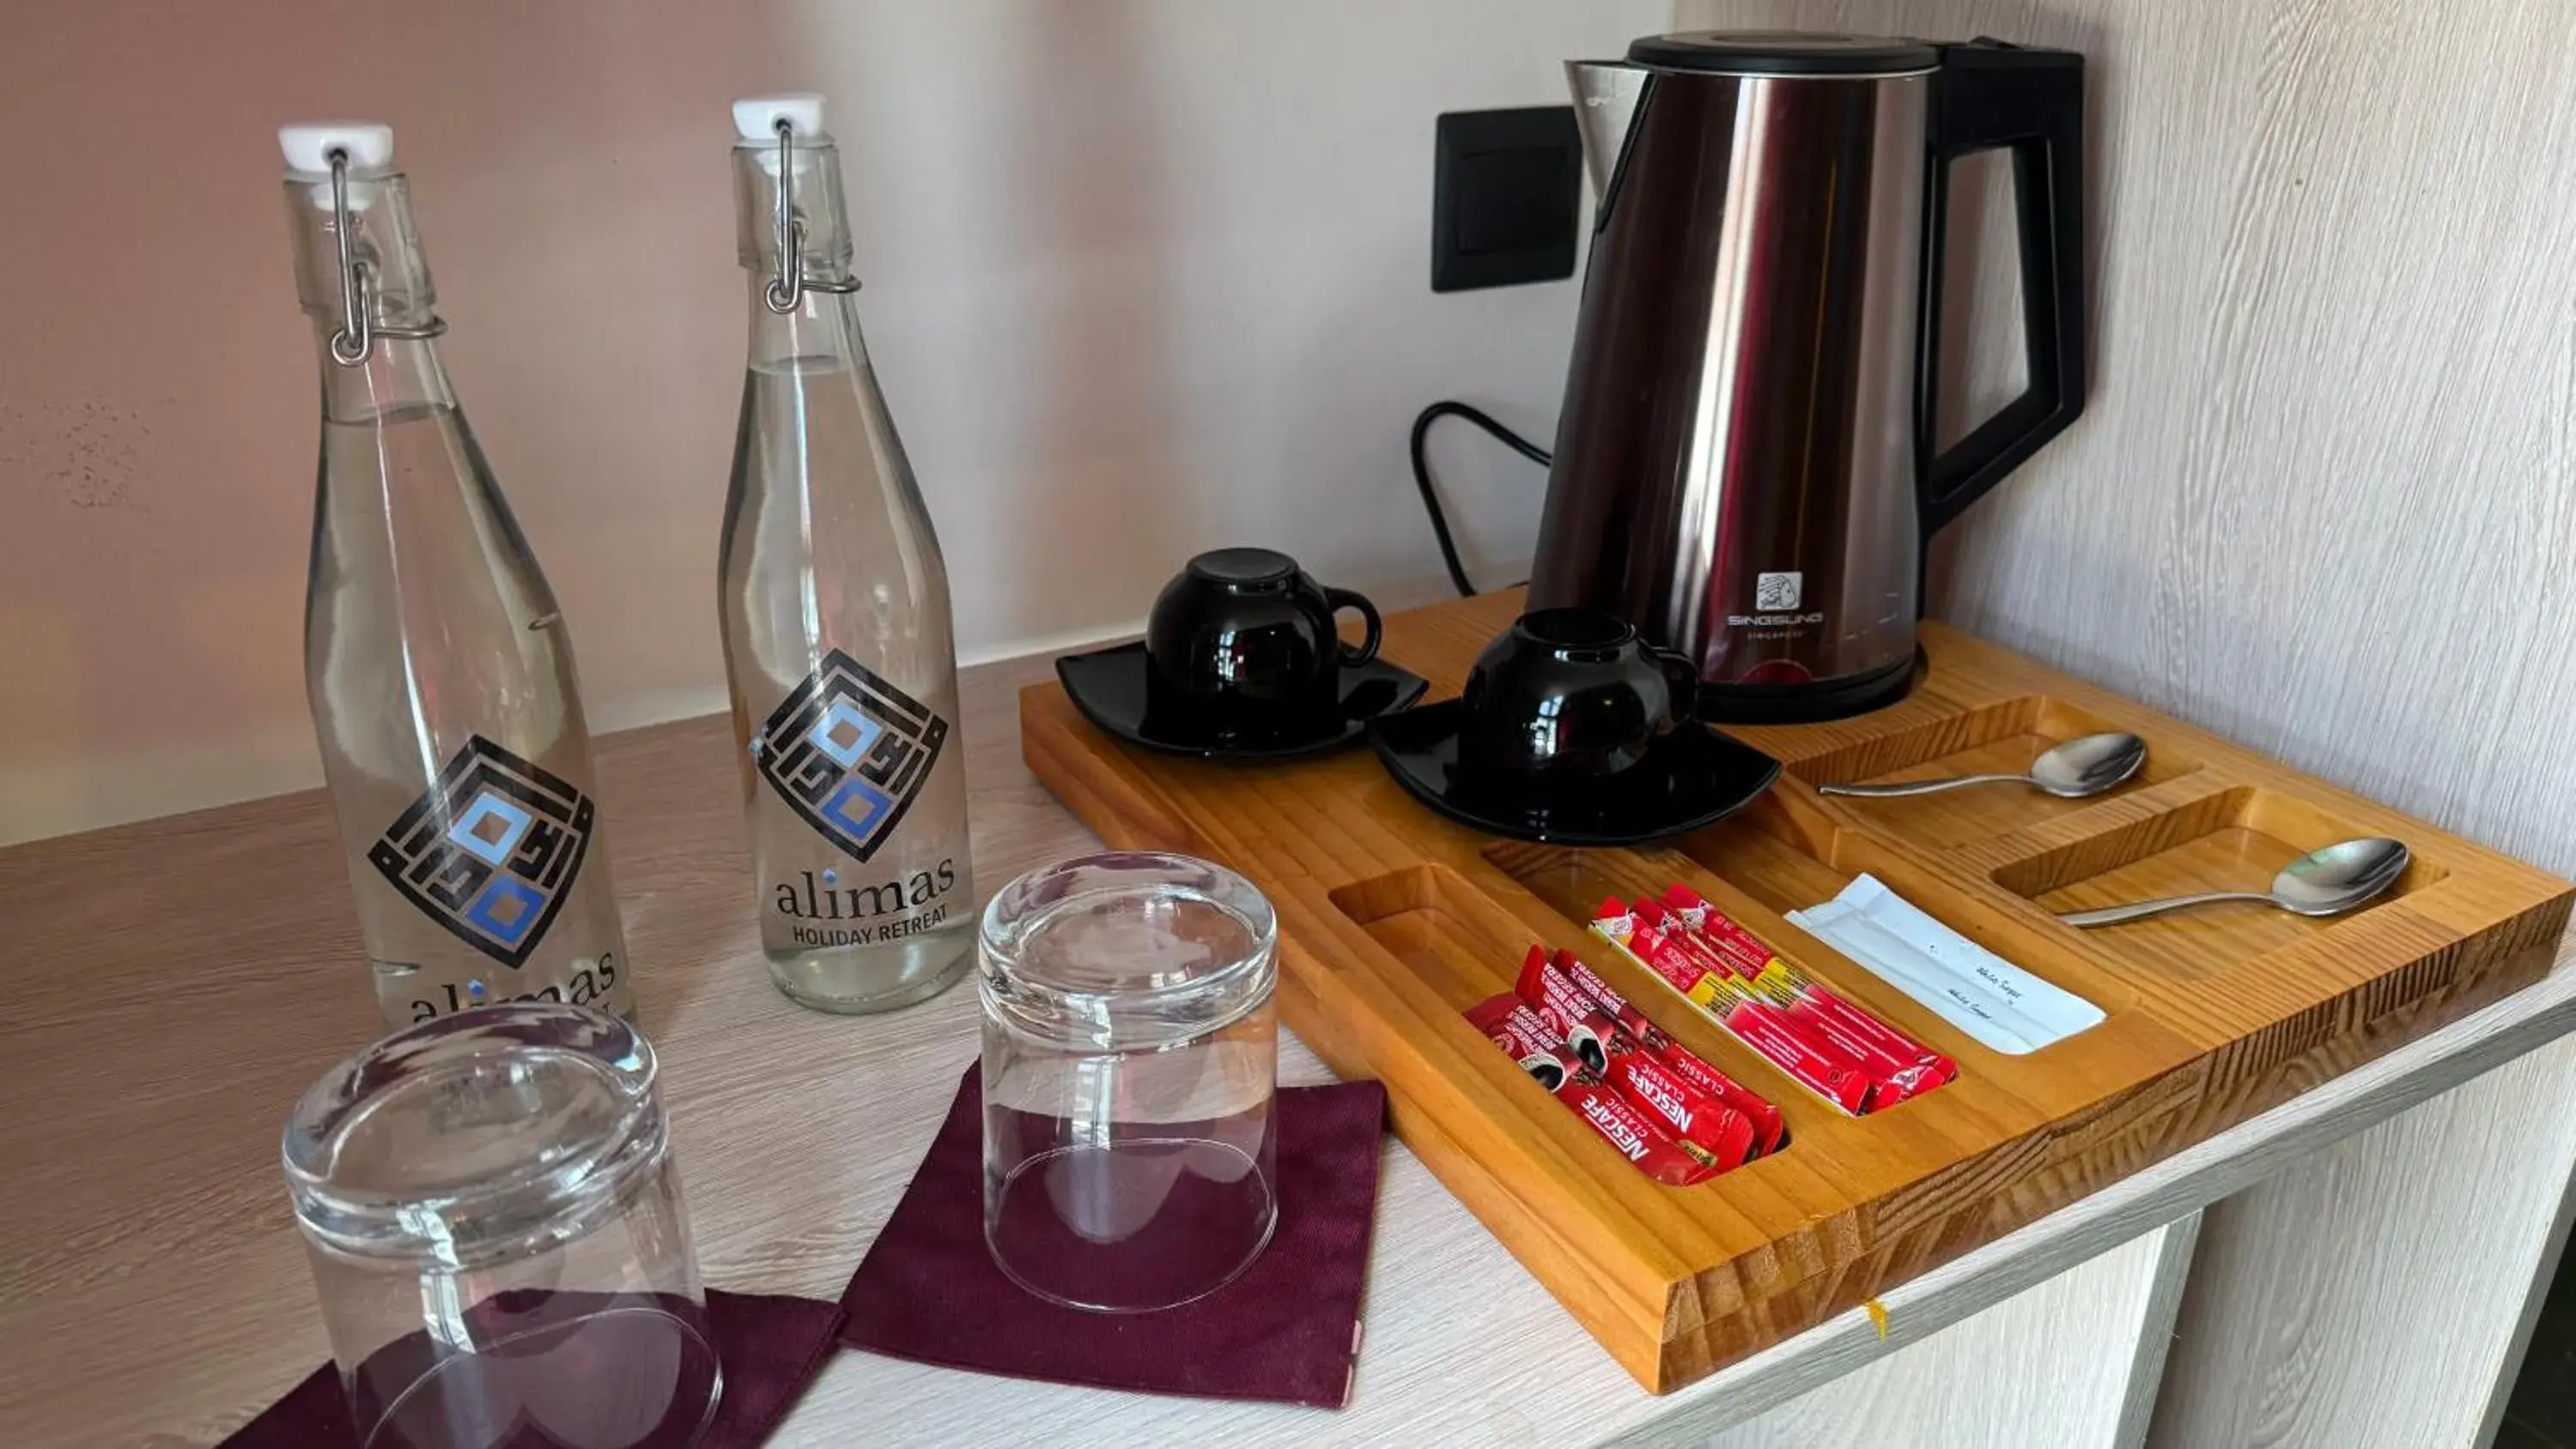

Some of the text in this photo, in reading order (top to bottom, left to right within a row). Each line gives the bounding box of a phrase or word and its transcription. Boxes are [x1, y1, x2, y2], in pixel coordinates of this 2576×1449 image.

[1728, 612, 1824, 627] SINGSUNG
[776, 858, 955, 919] alimas
[793, 903, 947, 946] HOLIDAY RETREAT
[1641, 1064, 1686, 1101] CLASSIC
[1677, 1058, 1725, 1095] CLASSIC
[1606, 1098, 1649, 1137] CLASSIC
